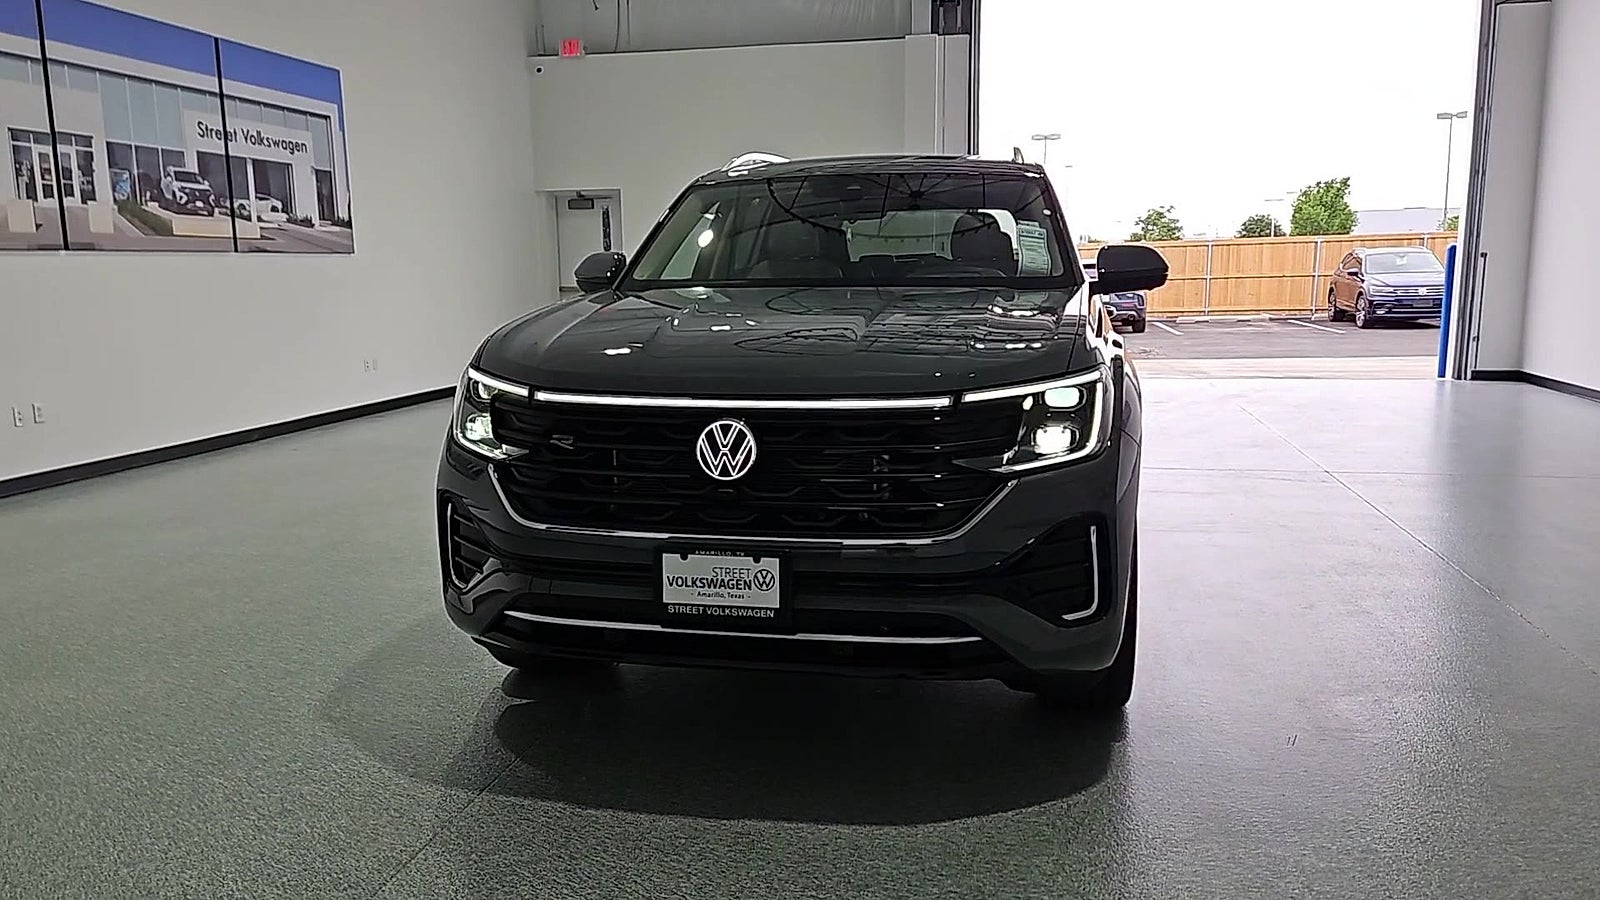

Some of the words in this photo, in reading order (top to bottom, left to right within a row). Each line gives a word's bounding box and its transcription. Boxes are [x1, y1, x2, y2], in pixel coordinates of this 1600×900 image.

[197, 121, 238, 143] Street
[241, 128, 308, 155] Volkswagen
[711, 567, 752, 579] STREET
[667, 575, 752, 591] VOLKSWAGEN
[696, 591, 727, 599] Amarillo,
[727, 592, 745, 600] Texas
[667, 605, 704, 614] STREET
[706, 606, 775, 618] VOLKSWAGEN
